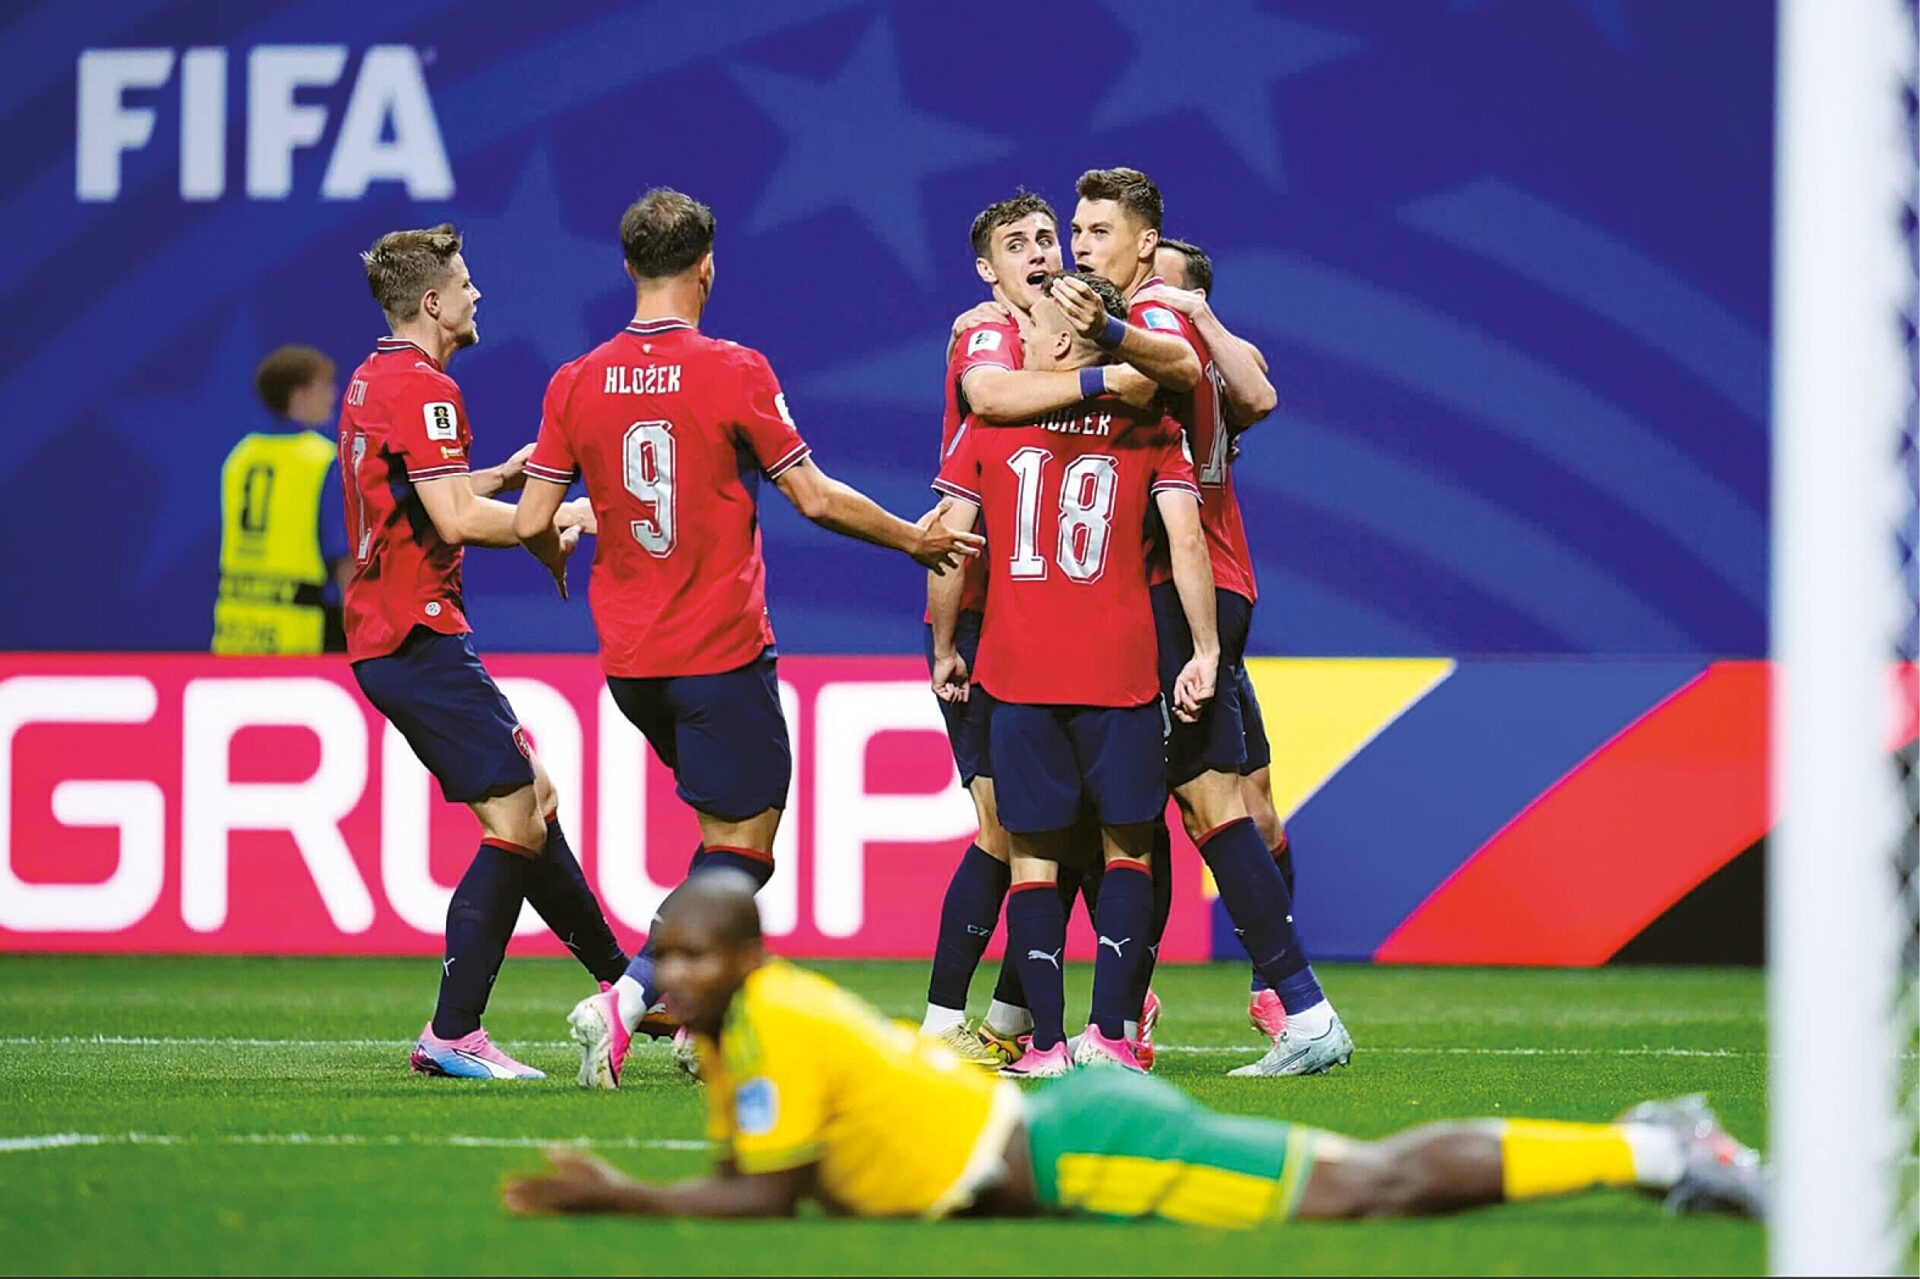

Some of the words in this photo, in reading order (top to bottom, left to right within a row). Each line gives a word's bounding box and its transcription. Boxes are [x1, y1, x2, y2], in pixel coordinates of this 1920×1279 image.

[76, 45, 456, 201] FIFA
[604, 364, 681, 395] HLOŽEK
[622, 419, 678, 559] 9
[1006, 446, 1118, 585] 18
[0, 676, 981, 938] GROUP
